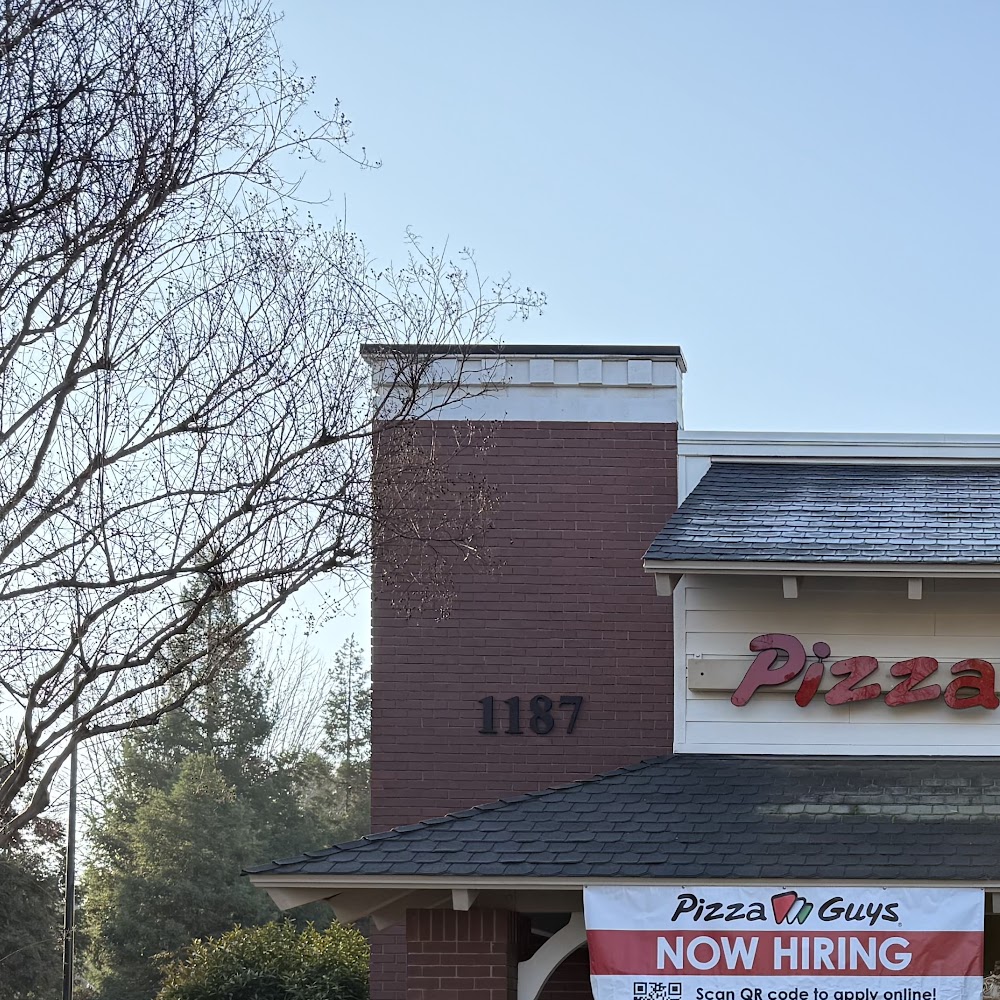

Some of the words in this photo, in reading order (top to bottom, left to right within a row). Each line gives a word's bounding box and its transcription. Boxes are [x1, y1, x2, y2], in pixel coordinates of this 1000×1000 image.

[730, 633, 1000, 710] Pizza
[478, 694, 583, 734] 1187
[671, 893, 768, 922] Pizza
[818, 897, 899, 926] Guys
[656, 936, 759, 970] NOW
[773, 936, 913, 971] HIRING
[696, 987, 735, 1000] Scan
[767, 987, 809, 1000] code
[814, 988, 829, 1000] to
[883, 987, 937, 1000] online!
